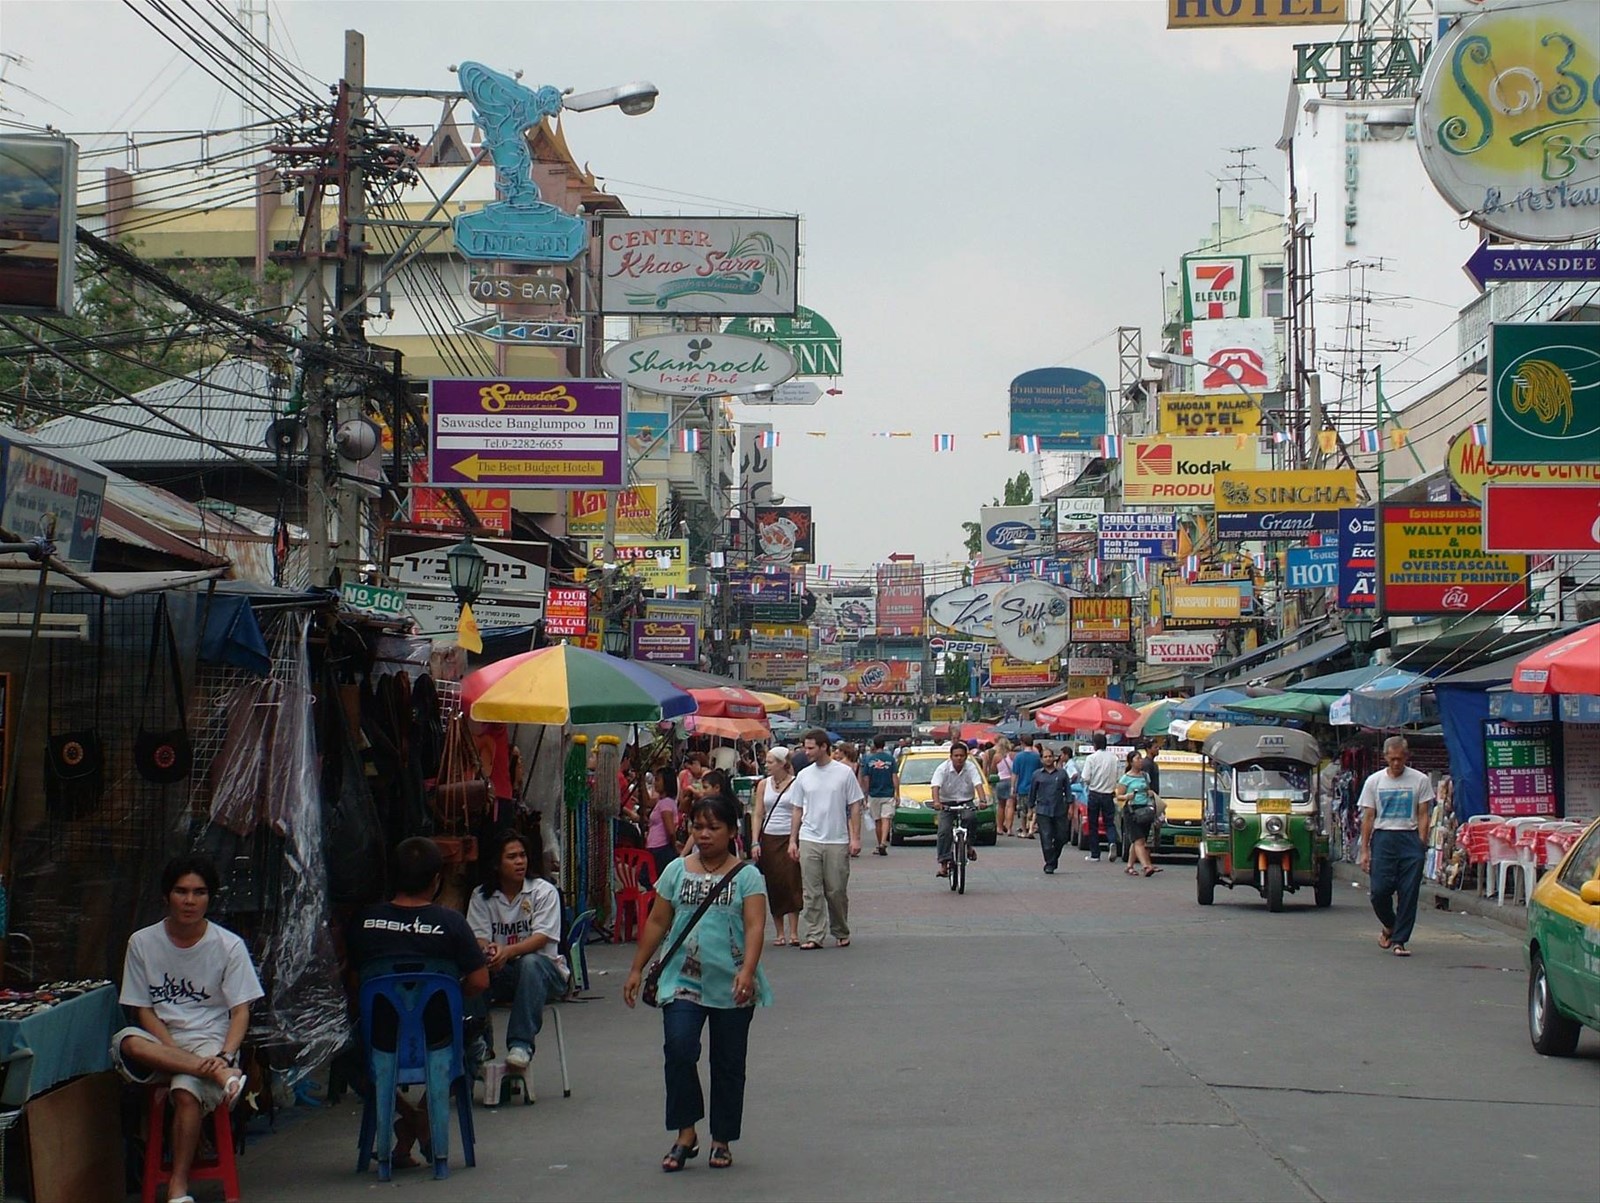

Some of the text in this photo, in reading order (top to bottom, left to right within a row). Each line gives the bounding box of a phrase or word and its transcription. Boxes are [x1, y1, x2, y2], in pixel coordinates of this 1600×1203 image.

[1292, 38, 1432, 84] KHA
[472, 232, 569, 252] UNICORN
[608, 229, 713, 251] CENTER
[607, 249, 766, 279] Khao Sarn
[1493, 257, 1597, 271] SAWASDEE
[470, 280, 562, 300] 70'S BAR
[627, 350, 770, 374] Shamrock
[659, 372, 738, 384] Irish Pub
[1217, 400, 1254, 411] PALACE
[441, 417, 614, 431] Sawasdee Banglumpoo Inn
[1176, 412, 1244, 426] HOTEL
[483, 438, 564, 449] Tel.0-2282-6655
[477, 461, 595, 474] The Best Budget Hotels
[1176, 460, 1232, 475] Kodak
[1151, 483, 1215, 497] PRODU
[1254, 486, 1351, 505] SINGHA
[617, 507, 652, 519] Place
[1102, 515, 1173, 525] CORAL GRAND
[1260, 513, 1315, 530] Grand
[1403, 526, 1482, 535] WALLY HO
[1448, 537, 1459, 547] &
[1352, 547, 1376, 557] Exc
[1401, 560, 1509, 571] OVERSEASCALL
[1390, 573, 1521, 583] INTERNET PRINTER
[373, 592, 403, 611] 160
[557, 591, 587, 600] TOUR
[1072, 599, 1128, 619] LUCKY BEER
[566, 618, 586, 627] CALL
[947, 641, 987, 652] PEPSI
[1485, 723, 1551, 736] Massage
[1263, 737, 1284, 745] TAXI
